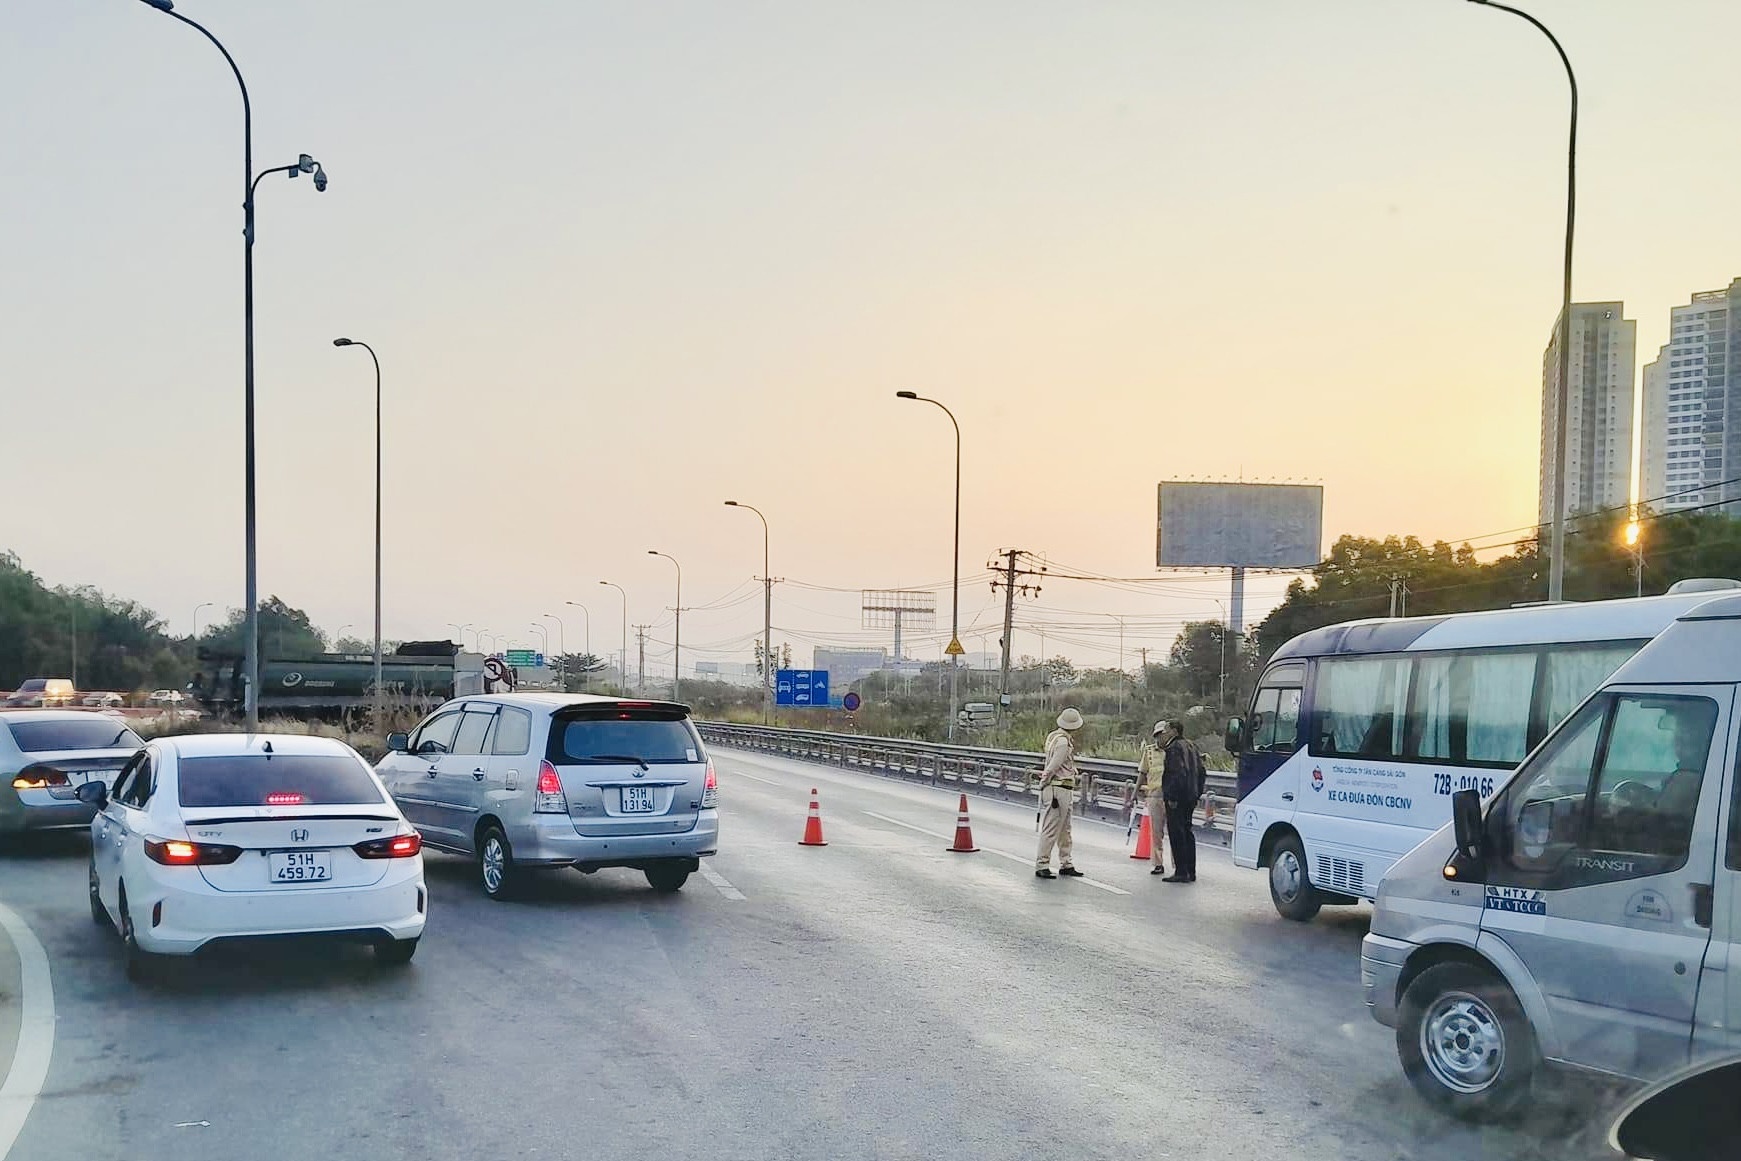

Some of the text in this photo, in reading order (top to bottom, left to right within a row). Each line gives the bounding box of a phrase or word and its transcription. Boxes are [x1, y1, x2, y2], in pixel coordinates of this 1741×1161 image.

[1434, 773, 1451, 795] 72B
[629, 788, 647, 799] 51H
[1328, 790, 1337, 801] XE
[1338, 791, 1348, 802] CA
[1385, 795, 1412, 809] CBCNV
[287, 853, 314, 866] 51H
[1577, 857, 1634, 872] TRANSIT
[278, 866, 325, 879] 459.72
[1503, 888, 1528, 899] HTX
